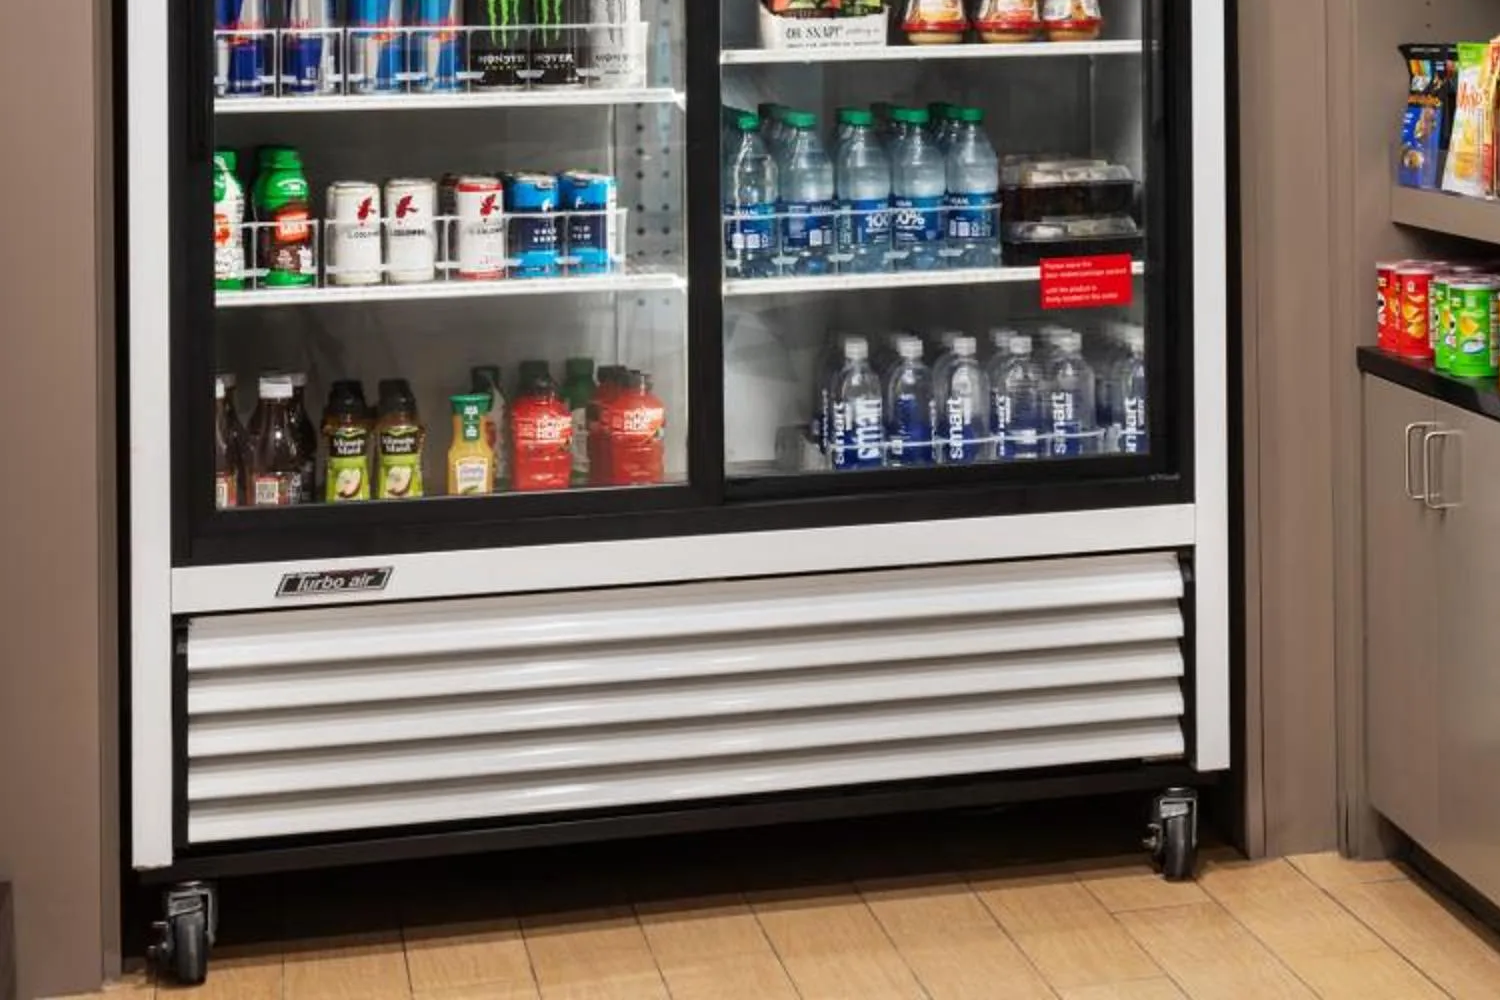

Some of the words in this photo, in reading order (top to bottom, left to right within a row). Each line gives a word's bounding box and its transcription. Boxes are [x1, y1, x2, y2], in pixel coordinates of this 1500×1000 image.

[853, 398, 883, 460] smart
[298, 572, 344, 591] Turbo
[350, 573, 374, 588] air
